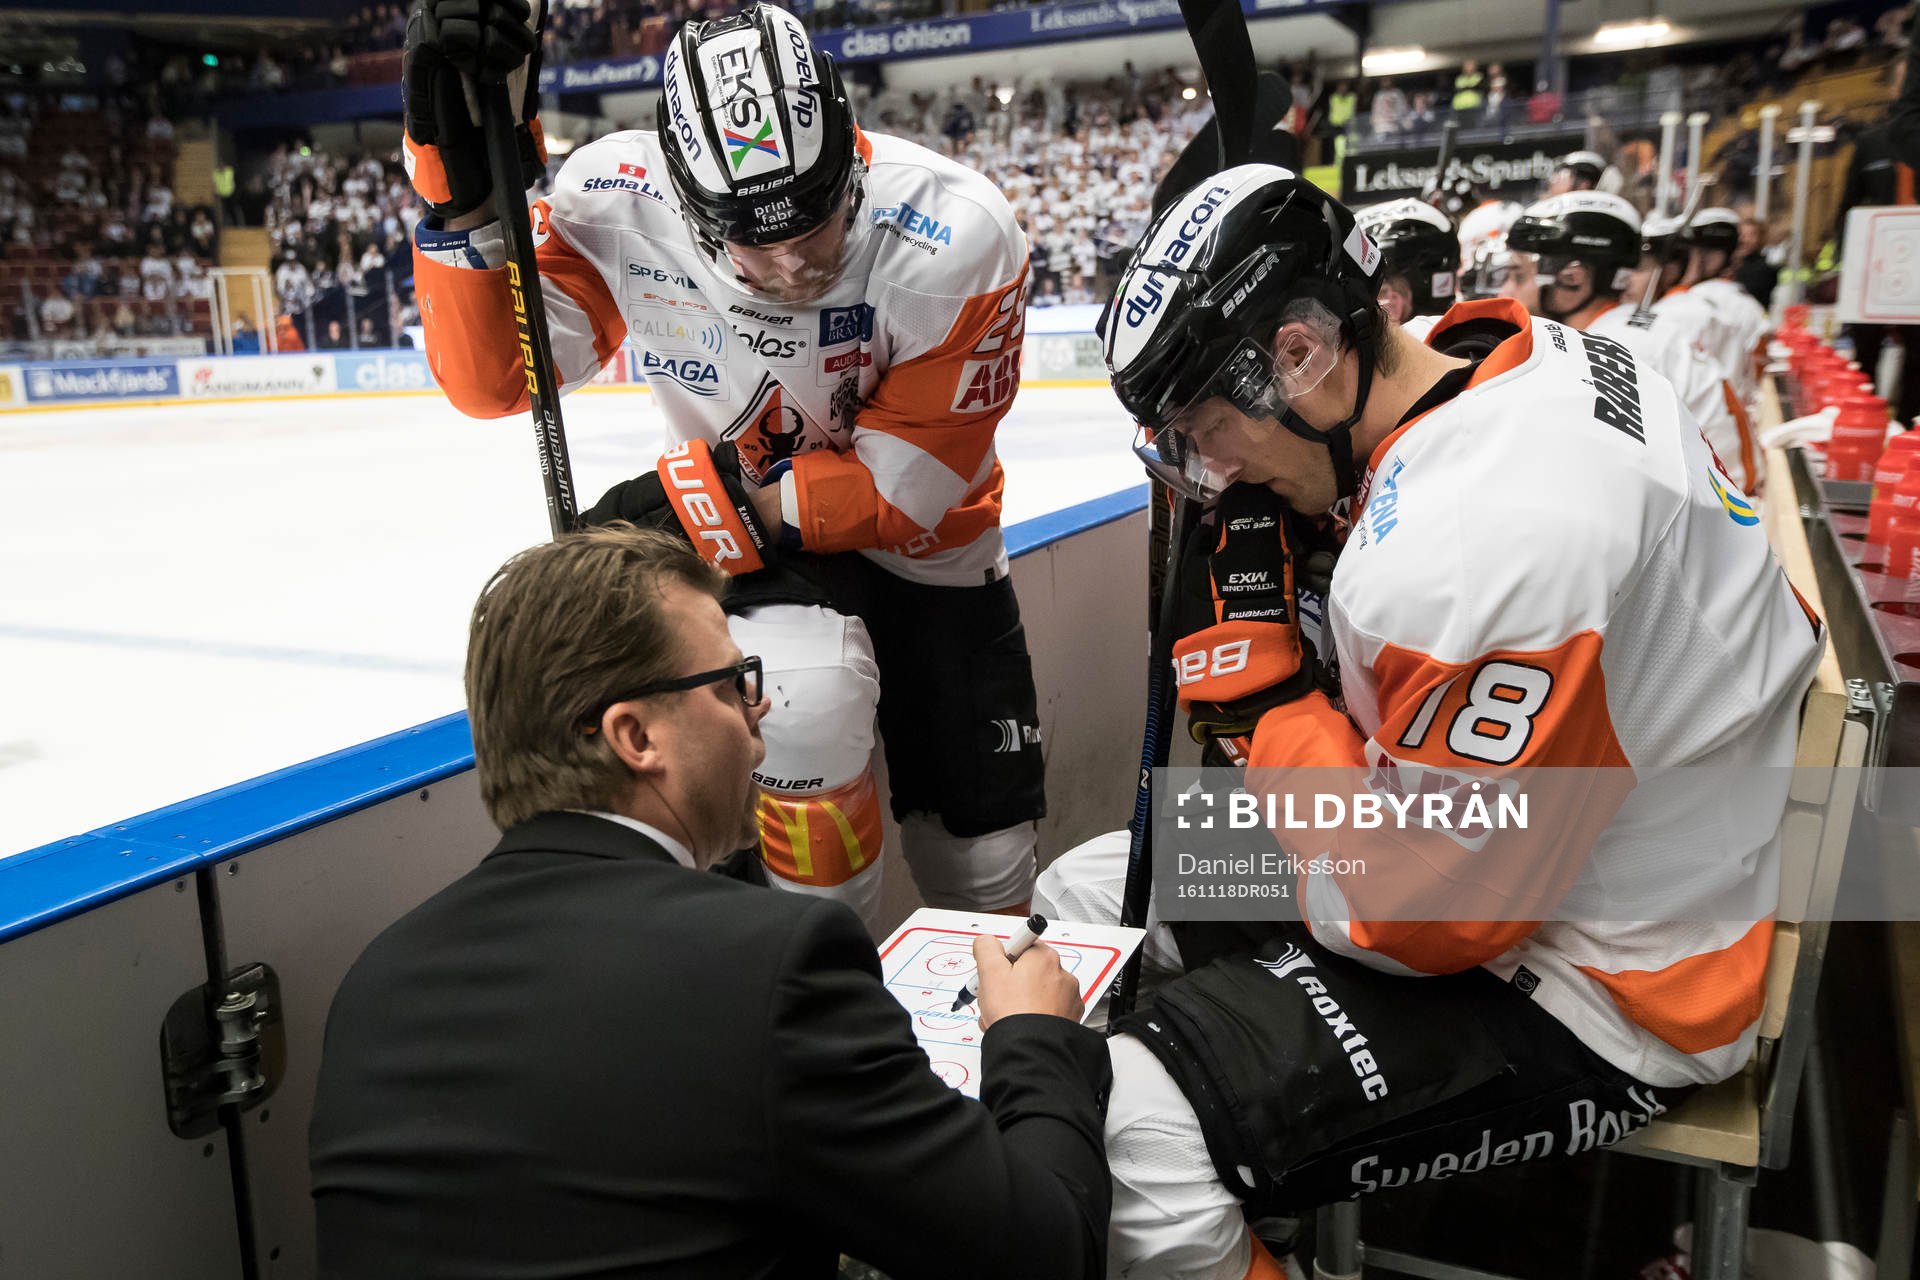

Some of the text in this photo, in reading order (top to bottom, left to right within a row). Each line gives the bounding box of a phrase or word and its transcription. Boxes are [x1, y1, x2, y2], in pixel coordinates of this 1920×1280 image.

[843, 23, 971, 58] clas ohlson
[718, 46, 763, 129] EKS
[784, 19, 819, 129] dynacon
[665, 50, 702, 162] dynacon
[581, 177, 664, 201] Stena Li
[737, 174, 795, 198] BAUER
[754, 196, 793, 219] print
[762, 209, 793, 225] fabr
[902, 235, 938, 256] recycling
[1126, 186, 1230, 329] dynacon
[1221, 251, 1280, 318] BAUER
[632, 319, 695, 342] CALL4U
[728, 304, 794, 325] BAUER
[356, 357, 426, 387] clas
[643, 351, 719, 383] BAGA
[1576, 329, 1647, 446] RÅBER
[534, 420, 550, 476] WIKLUND
[544, 409, 575, 513] SUPREME
[1228, 571, 1268, 583] MX3
[1228, 608, 1284, 619] SUPREME
[1397, 660, 1555, 766] 18
[751, 771, 825, 790] BAUER
[1297, 976, 1389, 1102] Roxtec
[1350, 1086, 1668, 1199] Sweden Rock
